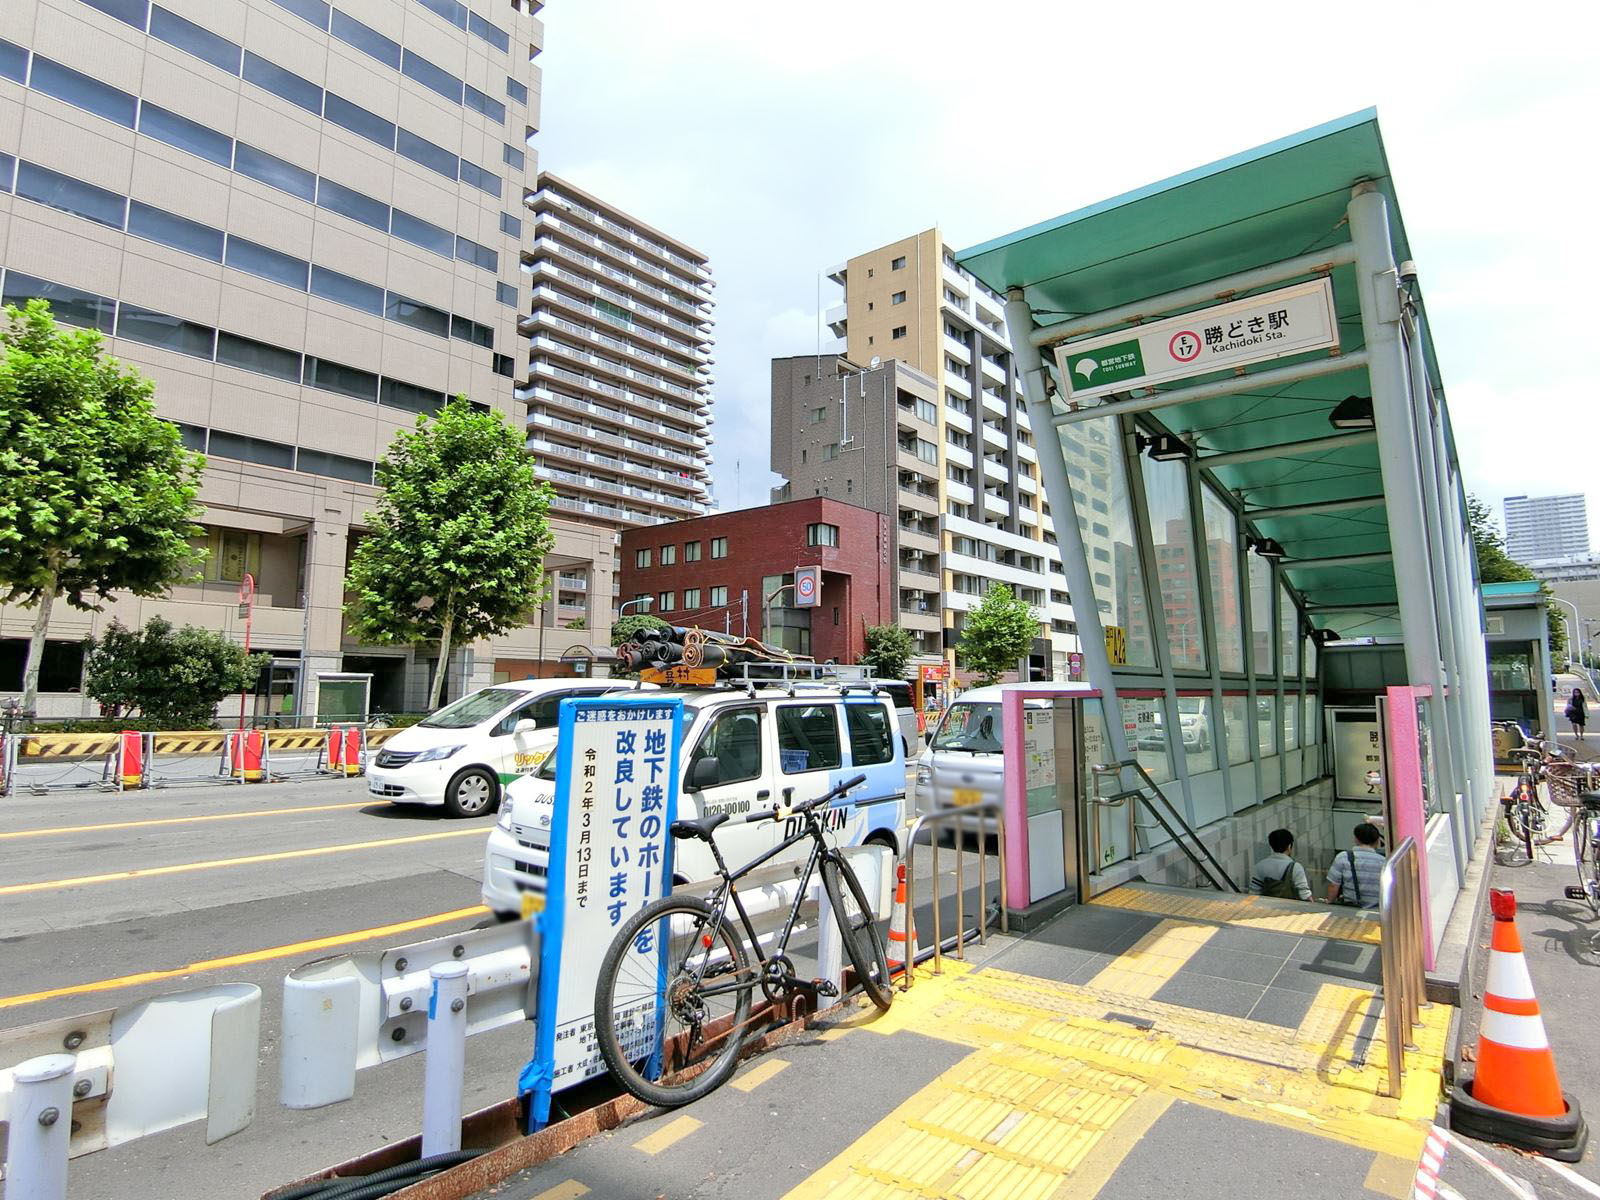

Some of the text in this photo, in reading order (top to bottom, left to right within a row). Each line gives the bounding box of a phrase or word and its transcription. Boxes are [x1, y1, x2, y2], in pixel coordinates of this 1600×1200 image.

[1204, 309, 1290, 345] 勝どき駅
[1180, 336, 1188, 345] E
[1211, 331, 1287, 354] Kachidoki Sta.
[1178, 345, 1194, 356] 17
[802, 582, 812, 592] 50
[576, 708, 673, 722] ご迷惑をおかけします
[534, 793, 555, 806] DUS
[704, 800, 751, 818] 0120-100100
[576, 748, 597, 908] 令和2年3月13日まで
[607, 730, 637, 927] 改良しています
[633, 728, 667, 954] 地下鉄のホーを
